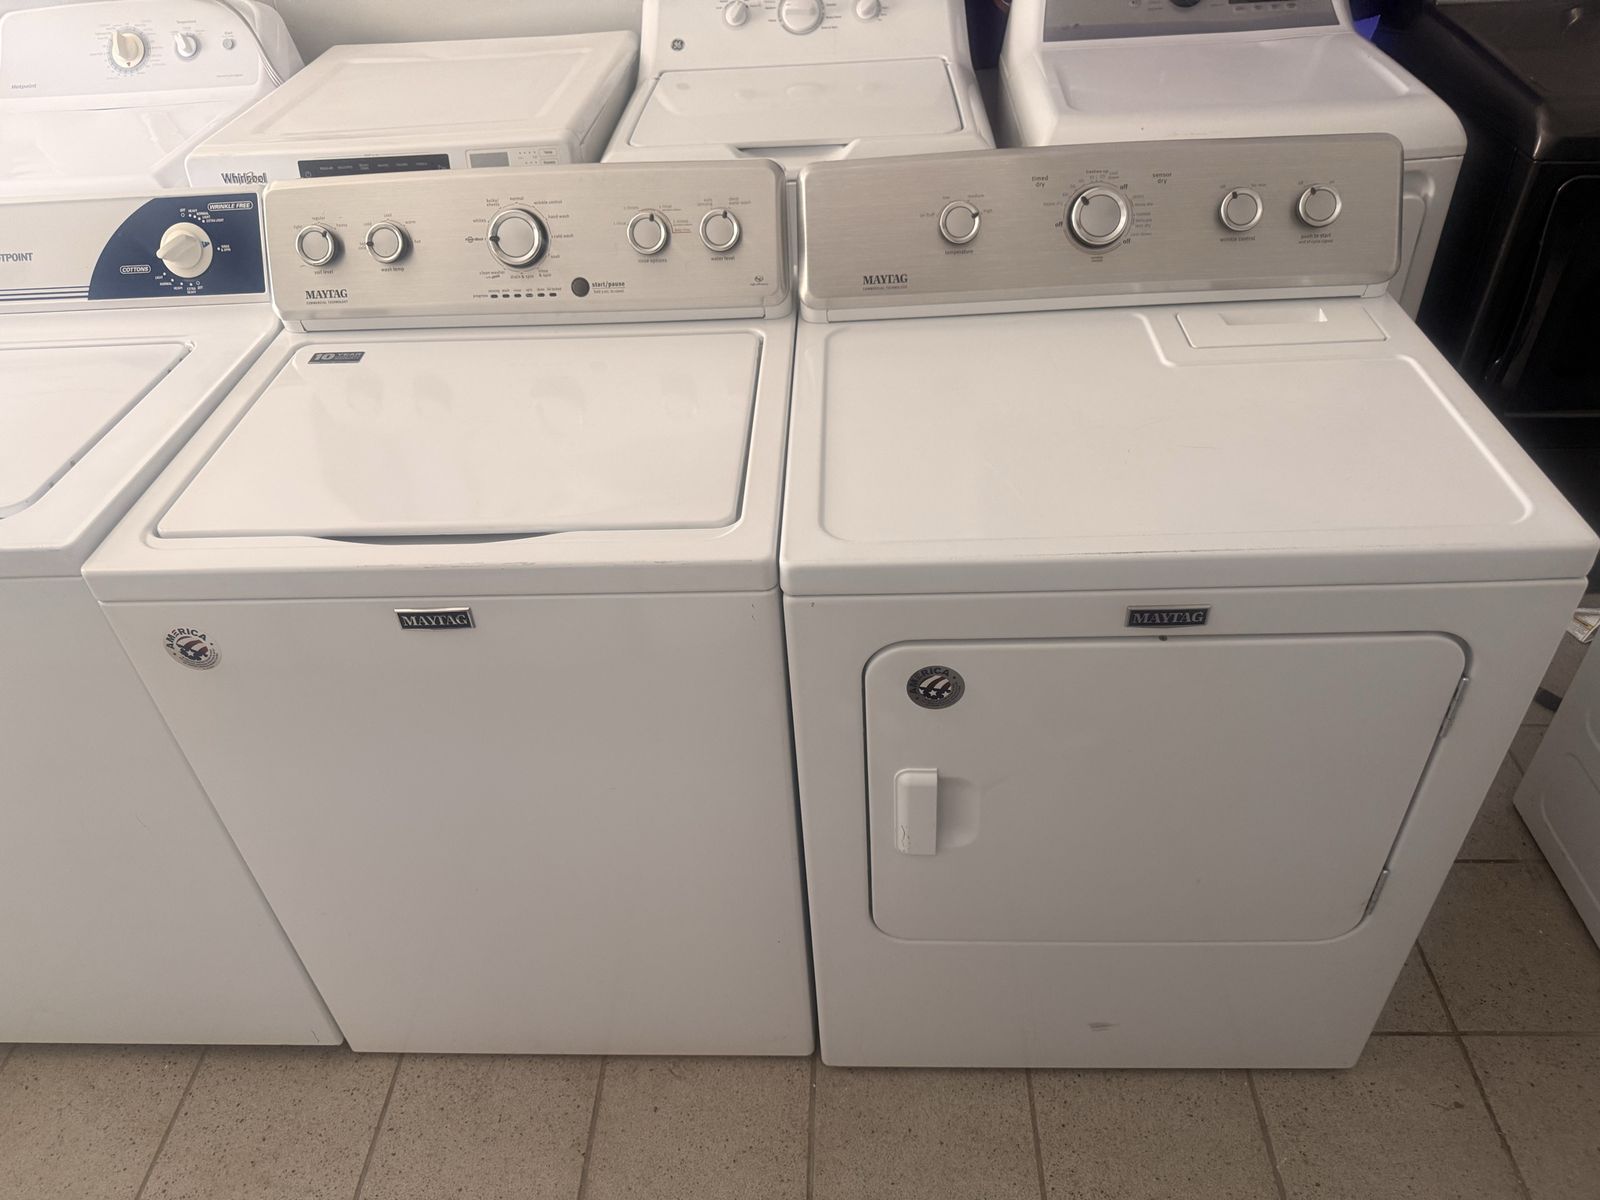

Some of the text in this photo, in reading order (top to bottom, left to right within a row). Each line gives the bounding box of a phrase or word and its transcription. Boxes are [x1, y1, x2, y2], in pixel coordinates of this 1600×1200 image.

[220, 171, 268, 185] Whirlpool
[0, 252, 33, 262] TPOINT
[863, 274, 908, 285] MAYTAG
[305, 288, 348, 299] MAYTAG
[401, 614, 468, 626] MAYTAG
[1133, 612, 1204, 624] MAYTAG
[166, 628, 207, 650] AMERICA
[909, 667, 949, 694] AMERICA
